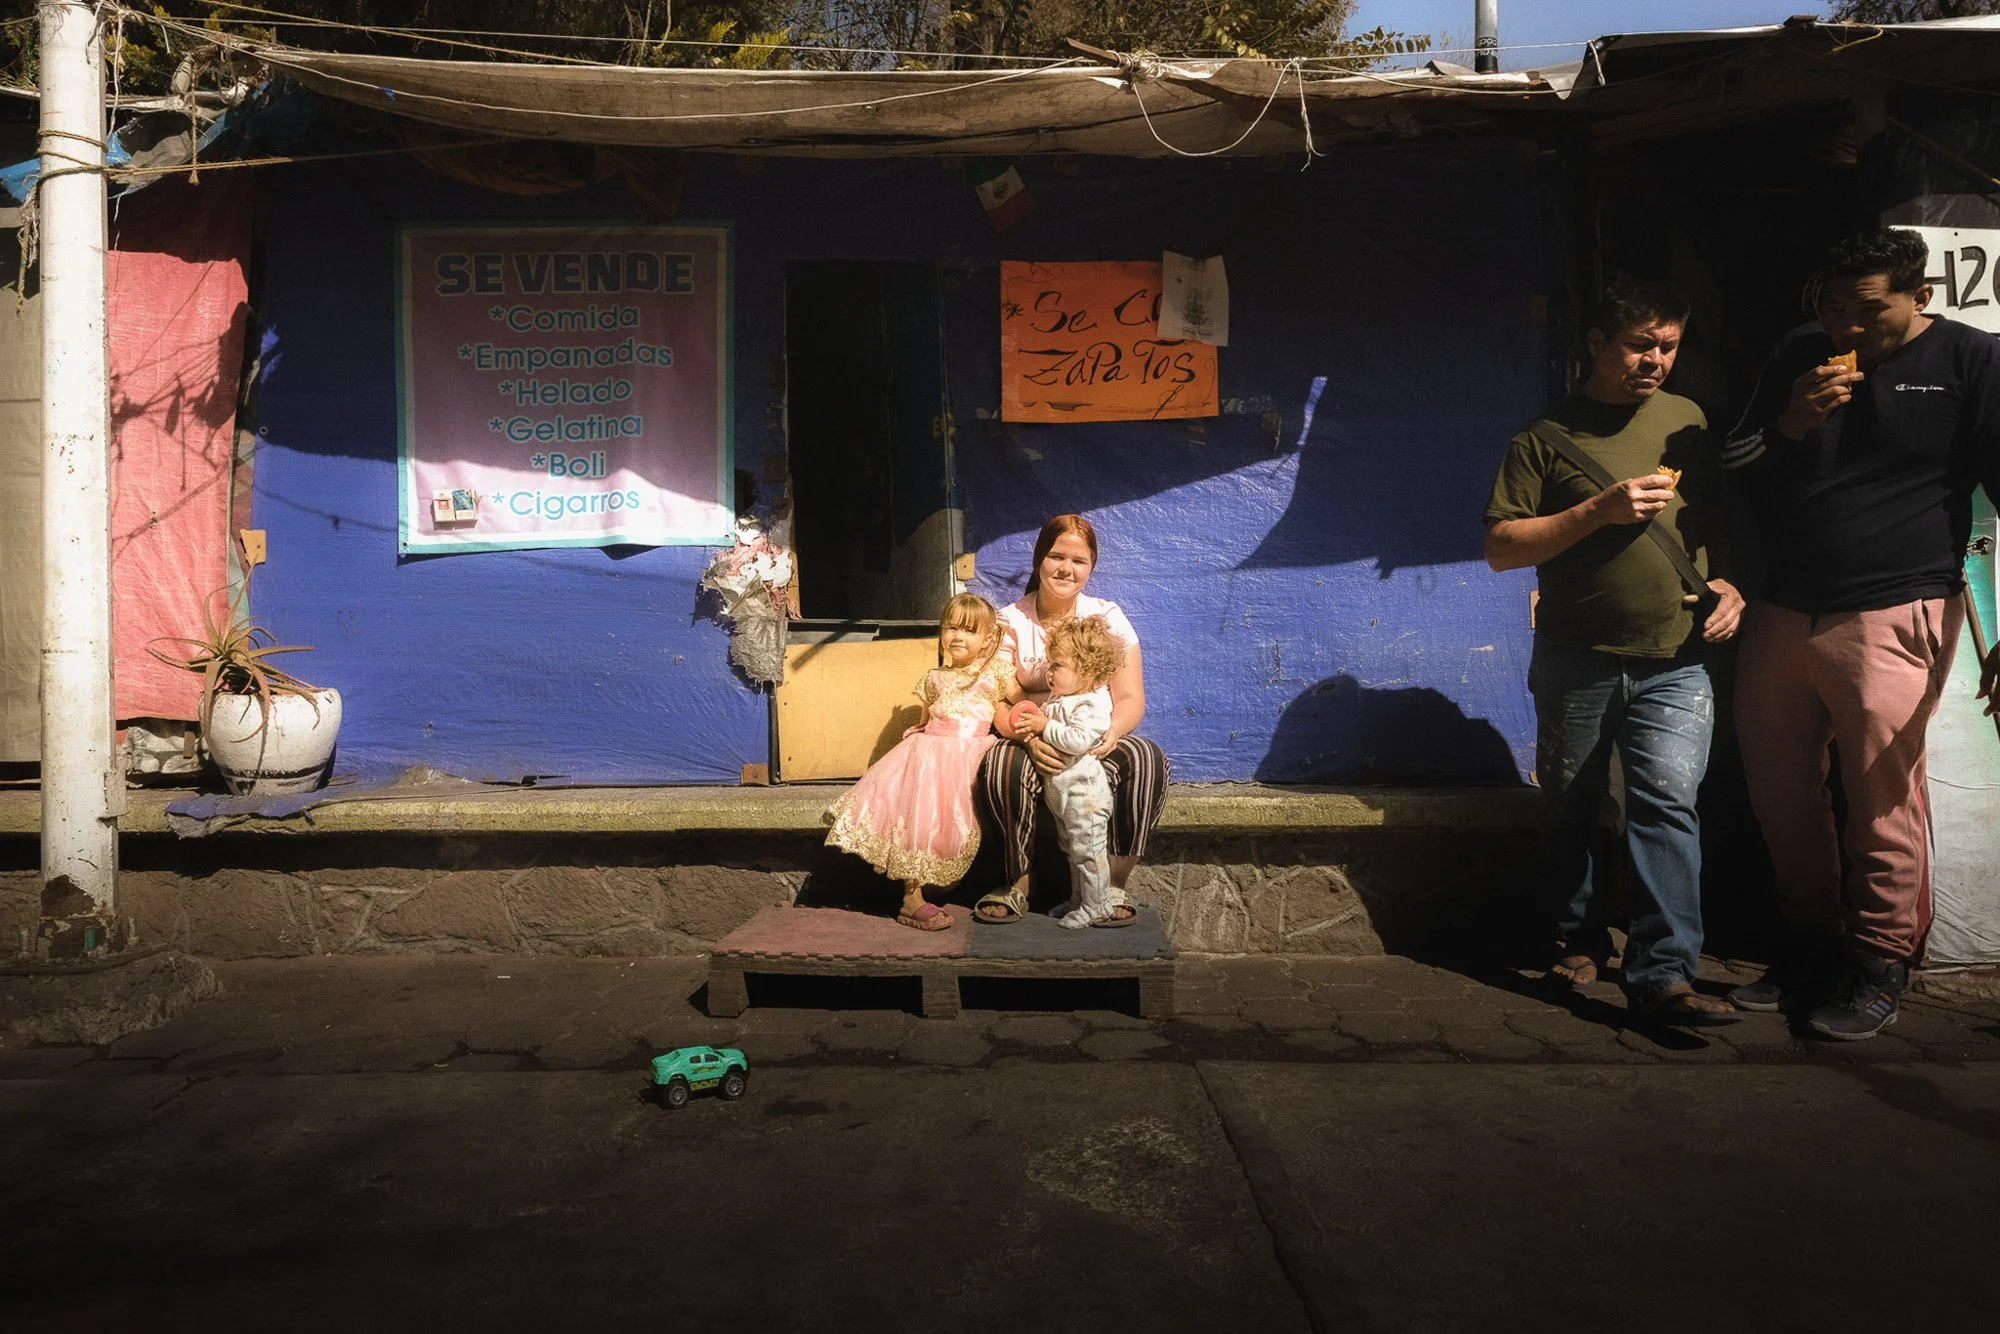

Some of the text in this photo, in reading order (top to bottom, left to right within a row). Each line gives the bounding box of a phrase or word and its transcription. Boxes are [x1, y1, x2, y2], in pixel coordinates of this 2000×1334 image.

[435, 251, 695, 296] SE VENDE
[1924, 246, 2000, 310] H2
